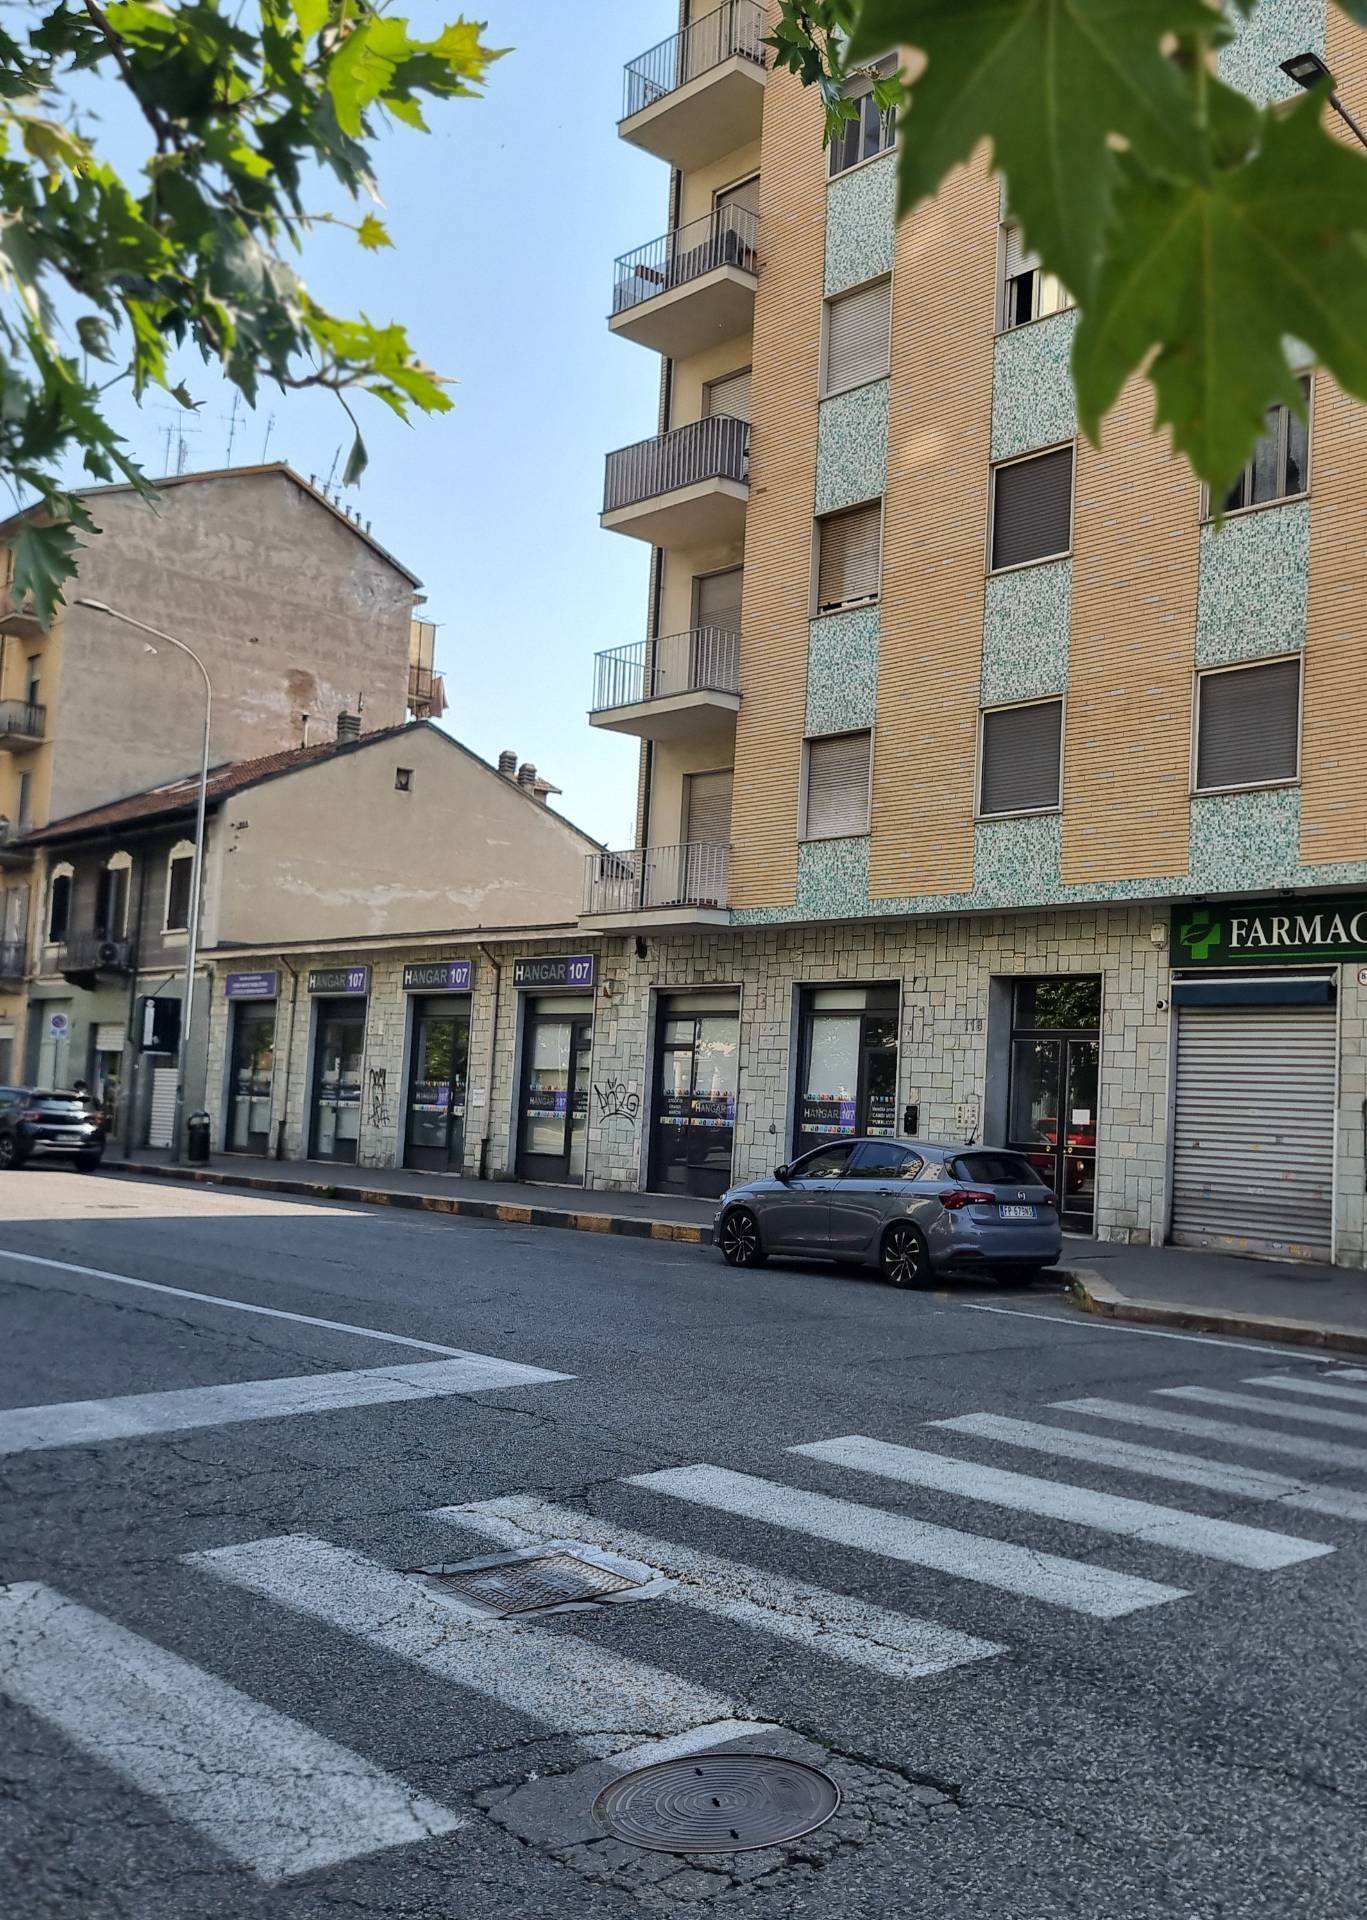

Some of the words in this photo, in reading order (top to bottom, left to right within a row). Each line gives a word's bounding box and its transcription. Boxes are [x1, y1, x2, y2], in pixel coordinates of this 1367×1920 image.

[1229, 911, 1367, 948] FARMAC
[404, 969, 448, 985] HANGAR
[450, 968, 468, 984] 107
[514, 964, 566, 981] HANGAR
[569, 963, 590, 979] 107
[309, 974, 347, 989] HANGAR
[348, 973, 364, 988] 107
[694, 1102, 727, 1113] HANGAR
[804, 1108, 839, 1120] HANGAR
